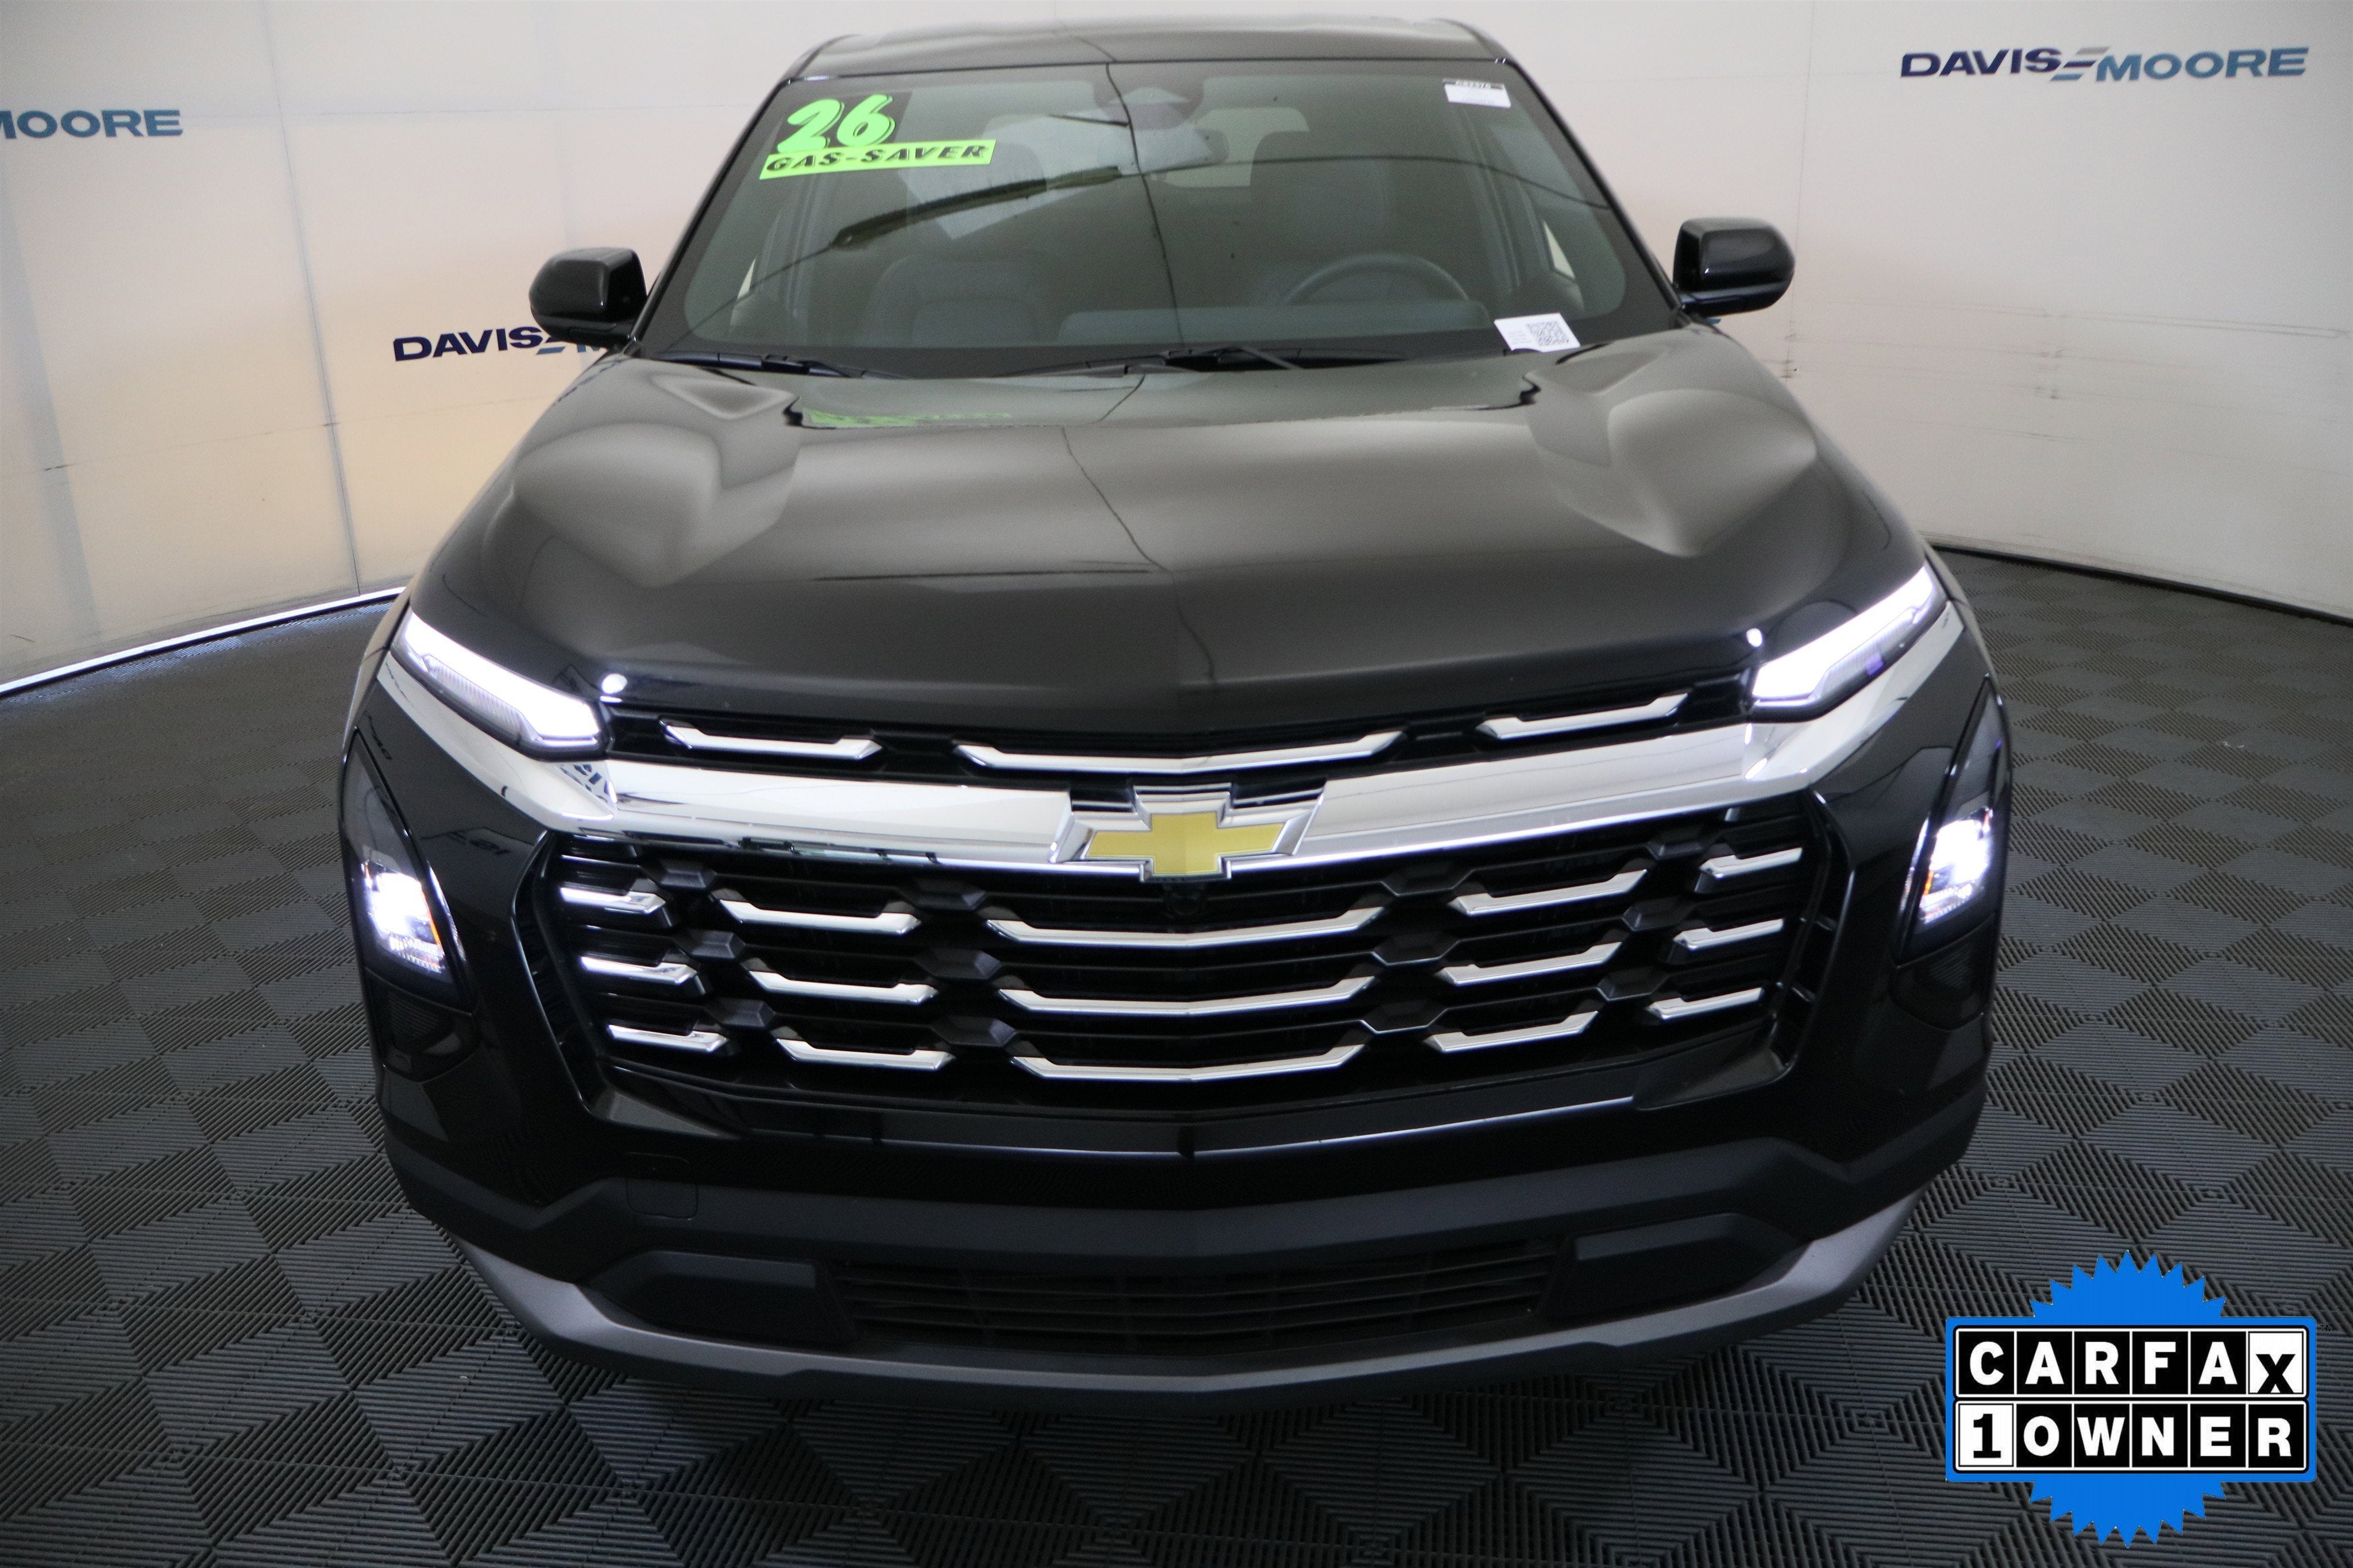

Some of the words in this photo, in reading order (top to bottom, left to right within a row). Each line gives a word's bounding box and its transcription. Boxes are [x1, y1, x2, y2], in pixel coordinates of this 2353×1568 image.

[1901, 48, 2061, 77] DAVIS
[2096, 47, 2309, 81] MOORE
[777, 94, 896, 153] 26
[766, 144, 988, 171] GAS-SAVER
[393, 326, 543, 362] DAVIS
